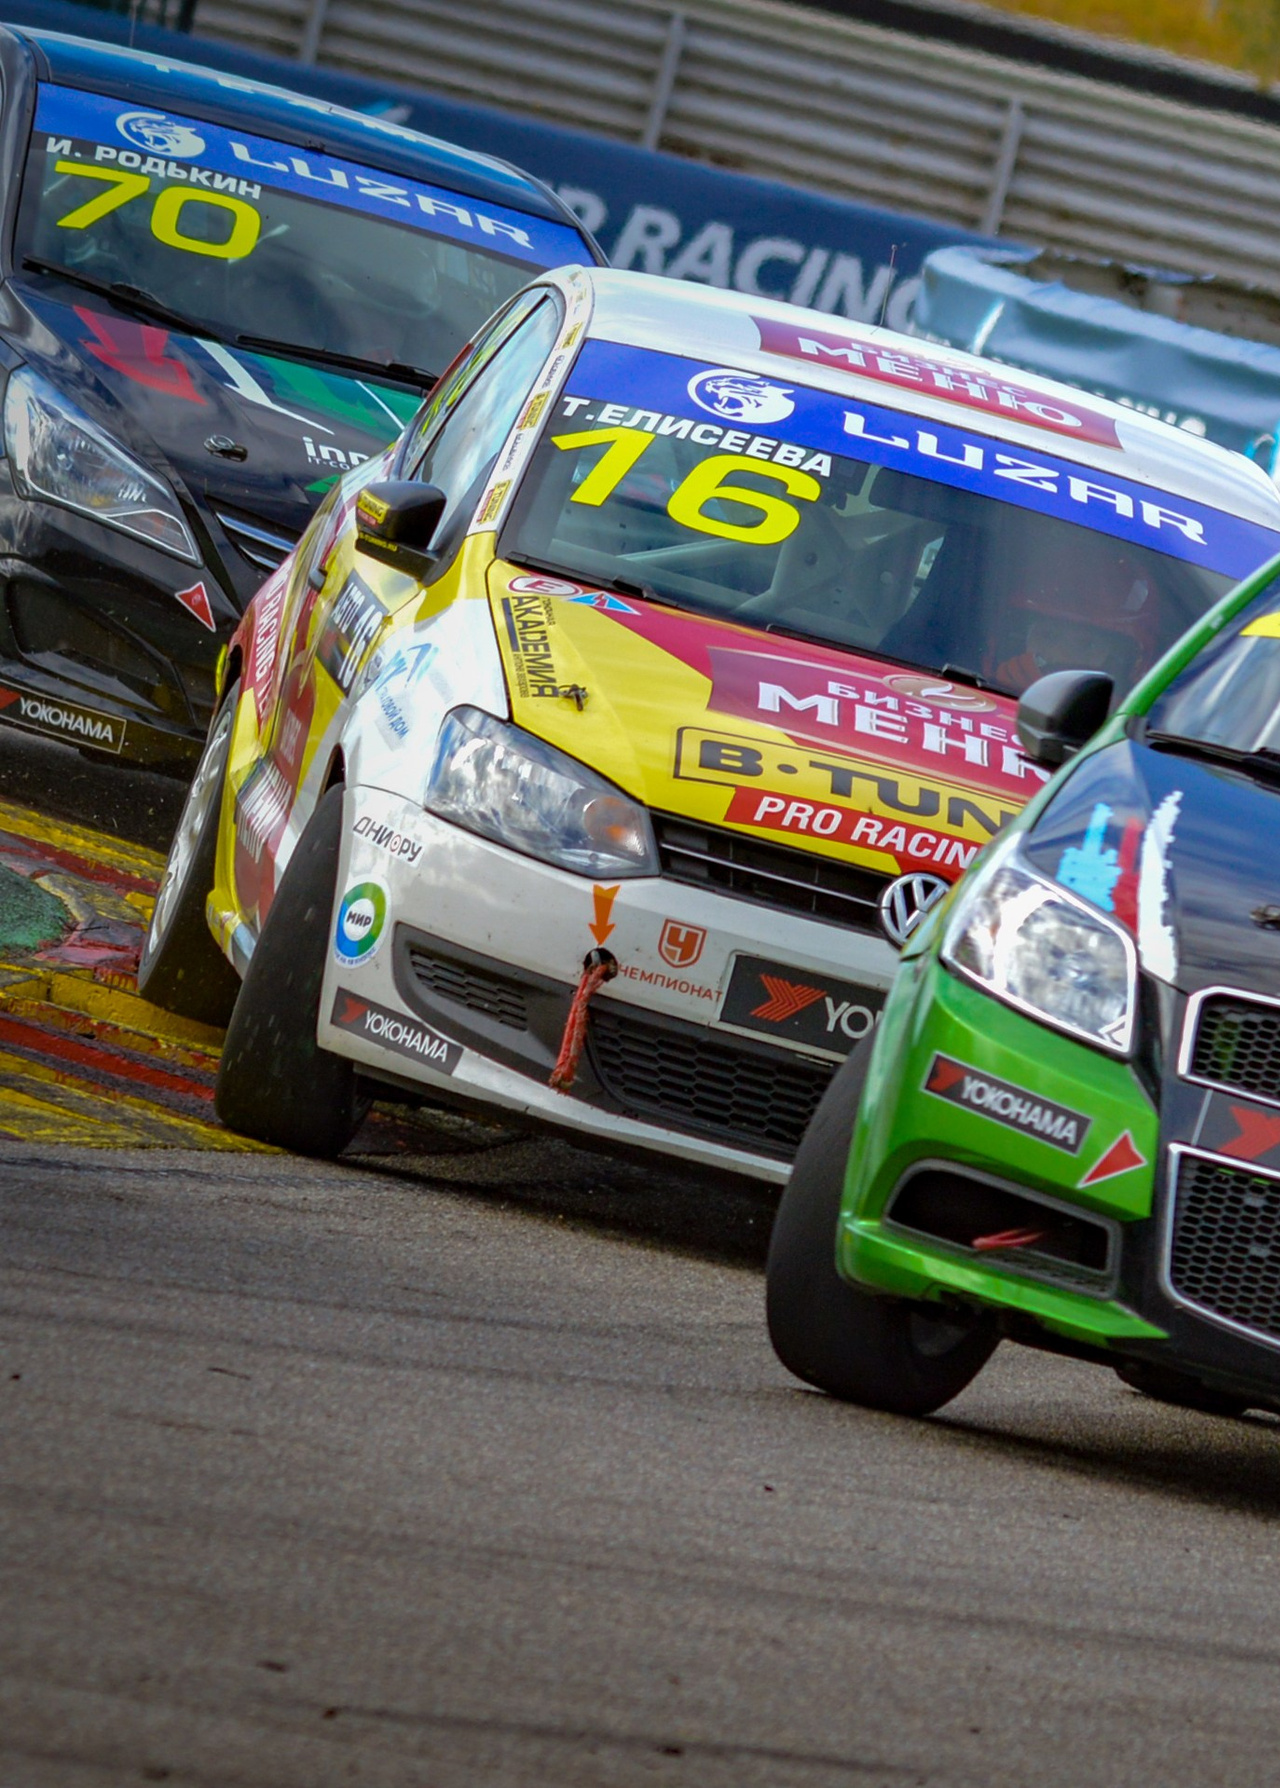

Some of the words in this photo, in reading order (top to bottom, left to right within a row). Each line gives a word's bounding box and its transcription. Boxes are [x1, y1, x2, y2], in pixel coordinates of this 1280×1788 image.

[95, 147, 262, 199] РОДЬКИН
[231, 142, 535, 250] LUZAR
[55, 160, 261, 261] 70
[798, 337, 1082, 427] МЕНЮ
[562, 397, 832, 478] Т.ЕЛИСЕЕВА
[551, 426, 821, 546] 16
[842, 410, 1207, 546] LUZAR
[19, 696, 113, 744] YOKOHAMA
[754, 796, 842, 836] PRO
[345, 910, 373, 929] МИР
[618, 963, 724, 1003] ЧЕМПИОНАТ
[364, 1010, 449, 1064] YOKOHAMA
[825, 996, 884, 1039] YO
[961, 1075, 1078, 1145] YOKOHAMA
